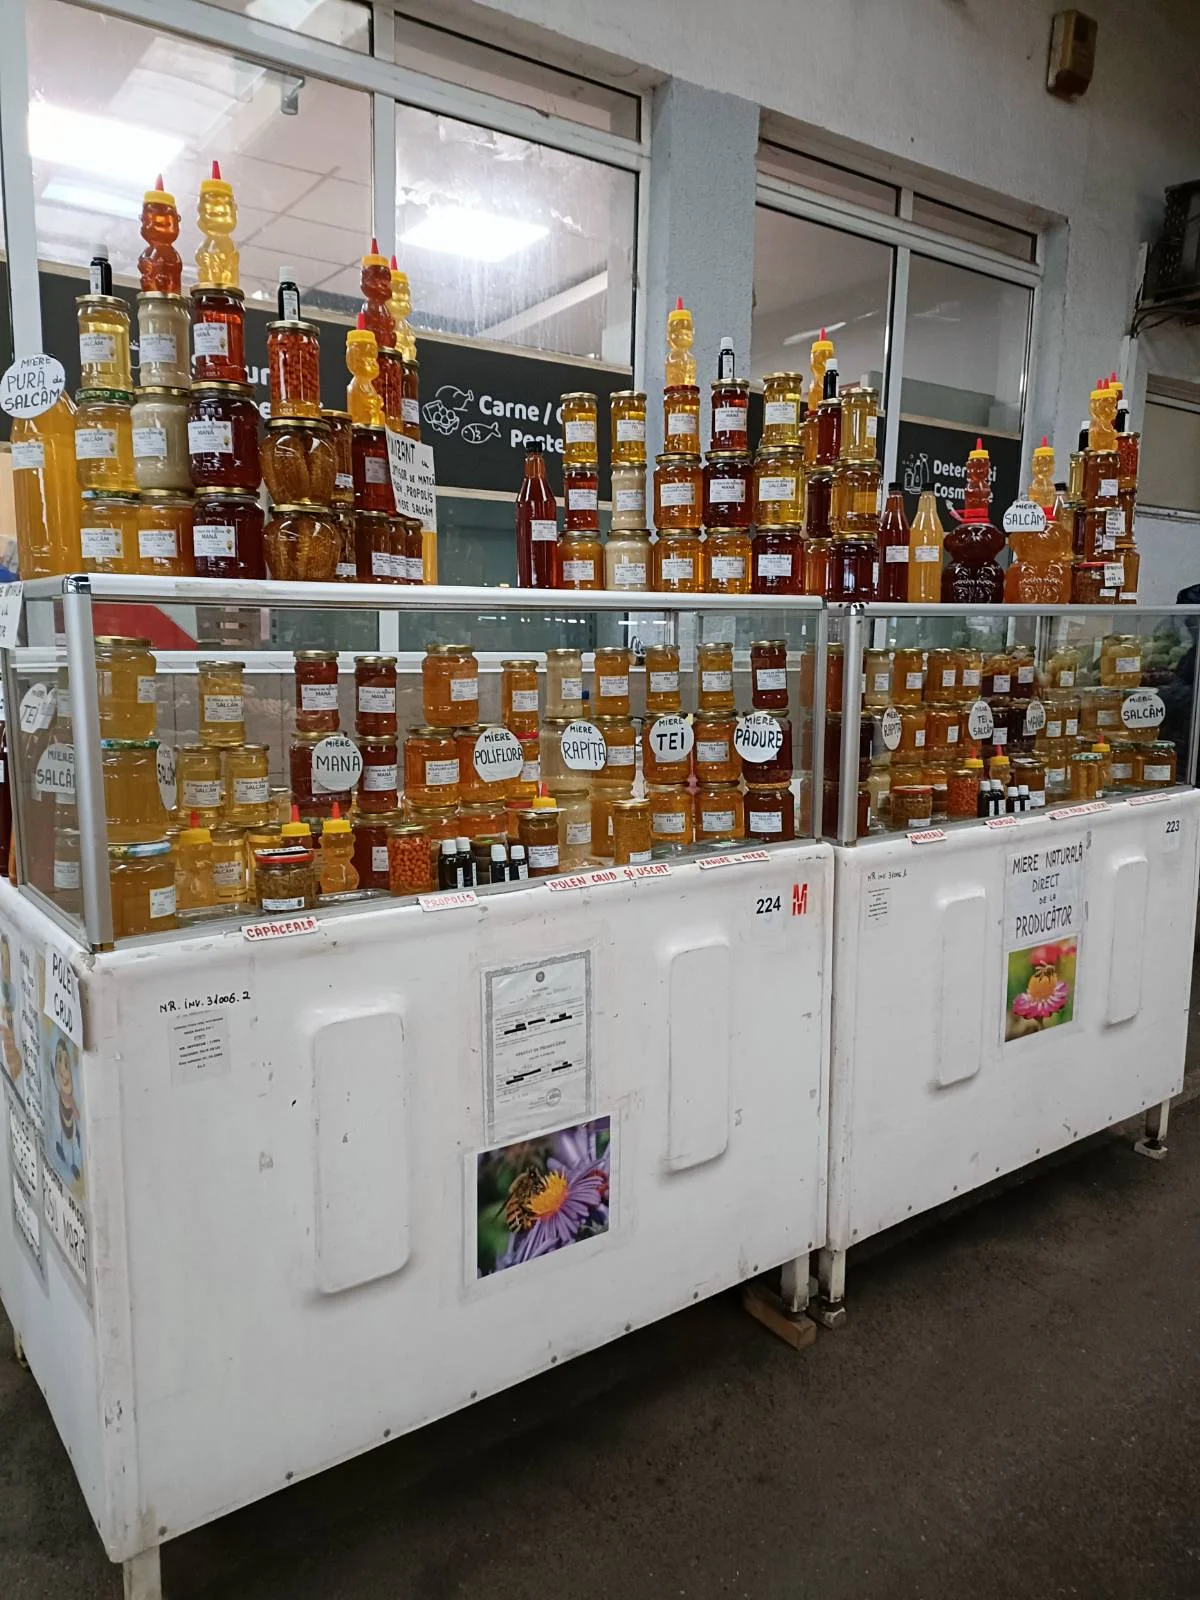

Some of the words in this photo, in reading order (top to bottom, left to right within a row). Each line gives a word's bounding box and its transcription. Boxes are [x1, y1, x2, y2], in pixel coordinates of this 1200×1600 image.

[20, 357, 52, 368] MIERE
[7, 367, 45, 393] PURĂ
[52, 374, 65, 384] de
[4, 386, 60, 411] SALCÂM
[479, 395, 540, 421] Carne
[569, 725, 593, 735] MIERE
[658, 717, 684, 728] MIERE
[744, 714, 775, 726] MIERE
[325, 740, 351, 748] MIERE
[484, 732, 511, 743] MIERE
[656, 727, 685, 751] TEI
[735, 724, 783, 749] PĂDURE
[316, 751, 361, 772] MANĂ
[474, 744, 524, 766] POLIFLORĂ
[1165, 820, 1180, 834] 223
[1012, 853, 1039, 875] MIERE
[1045, 841, 1083, 869] NATURALĂ
[550, 876, 586, 890] POLEN
[591, 871, 617, 883] CRUD
[636, 864, 669, 876] USCAT
[1031, 873, 1060, 892] DIRECT
[423, 893, 475, 908] PROPOLIS
[756, 895, 781, 914] 224
[1016, 905, 1072, 939] PRODUCĂTOR
